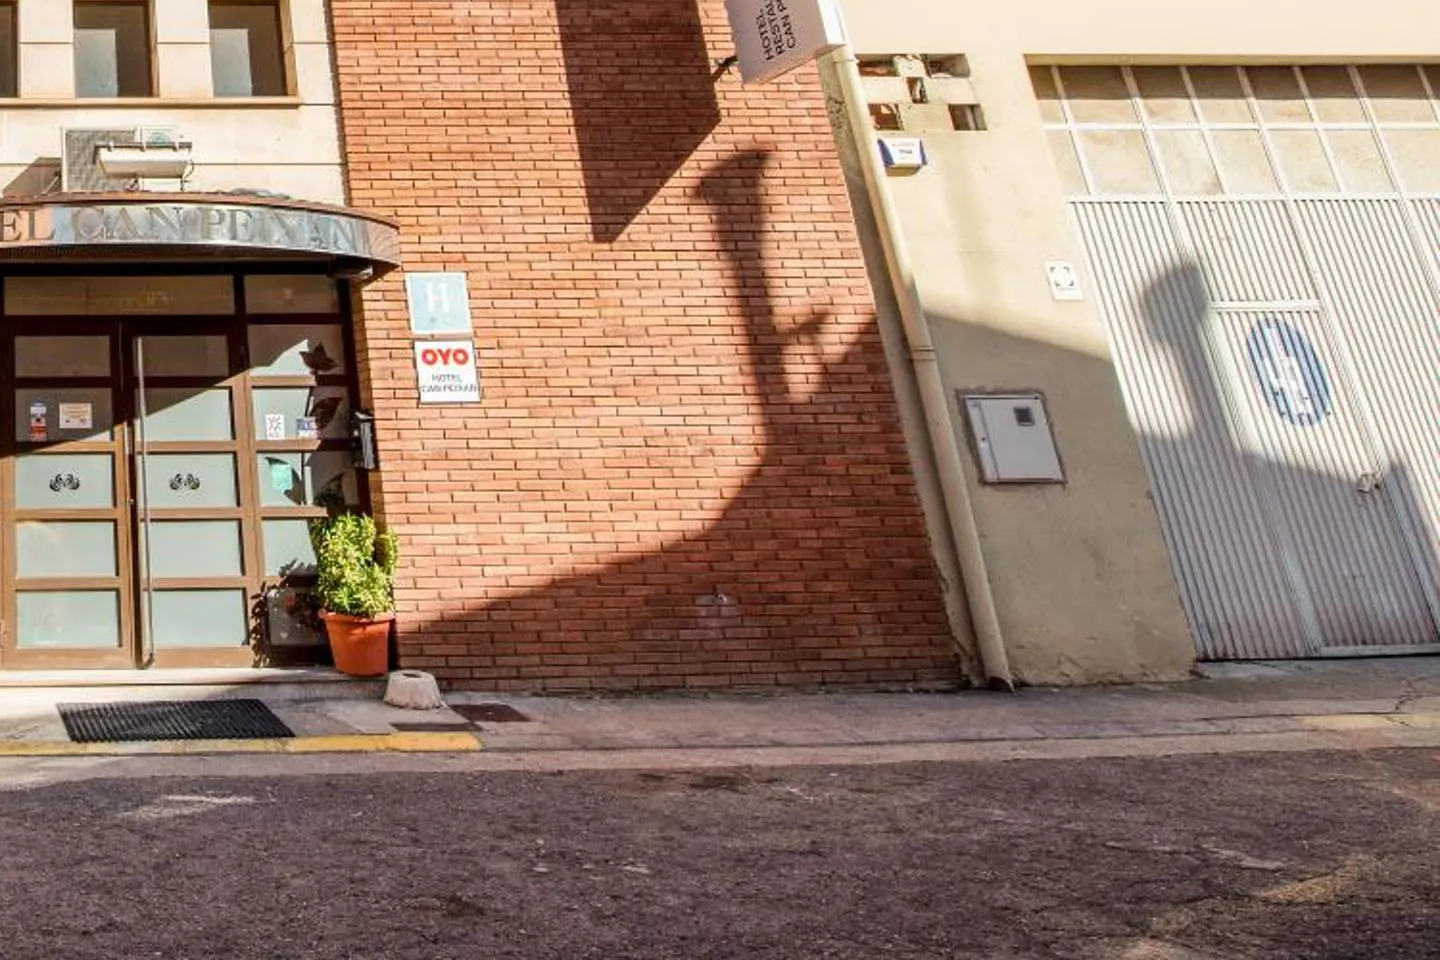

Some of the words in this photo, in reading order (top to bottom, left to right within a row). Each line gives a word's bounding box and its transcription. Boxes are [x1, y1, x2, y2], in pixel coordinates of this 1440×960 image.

[756, 9, 775, 60] HOTEL
[781, 14, 796, 49] CAN
[70, 206, 186, 241] CAN
[426, 282, 450, 312] H
[421, 348, 469, 366] OYO
